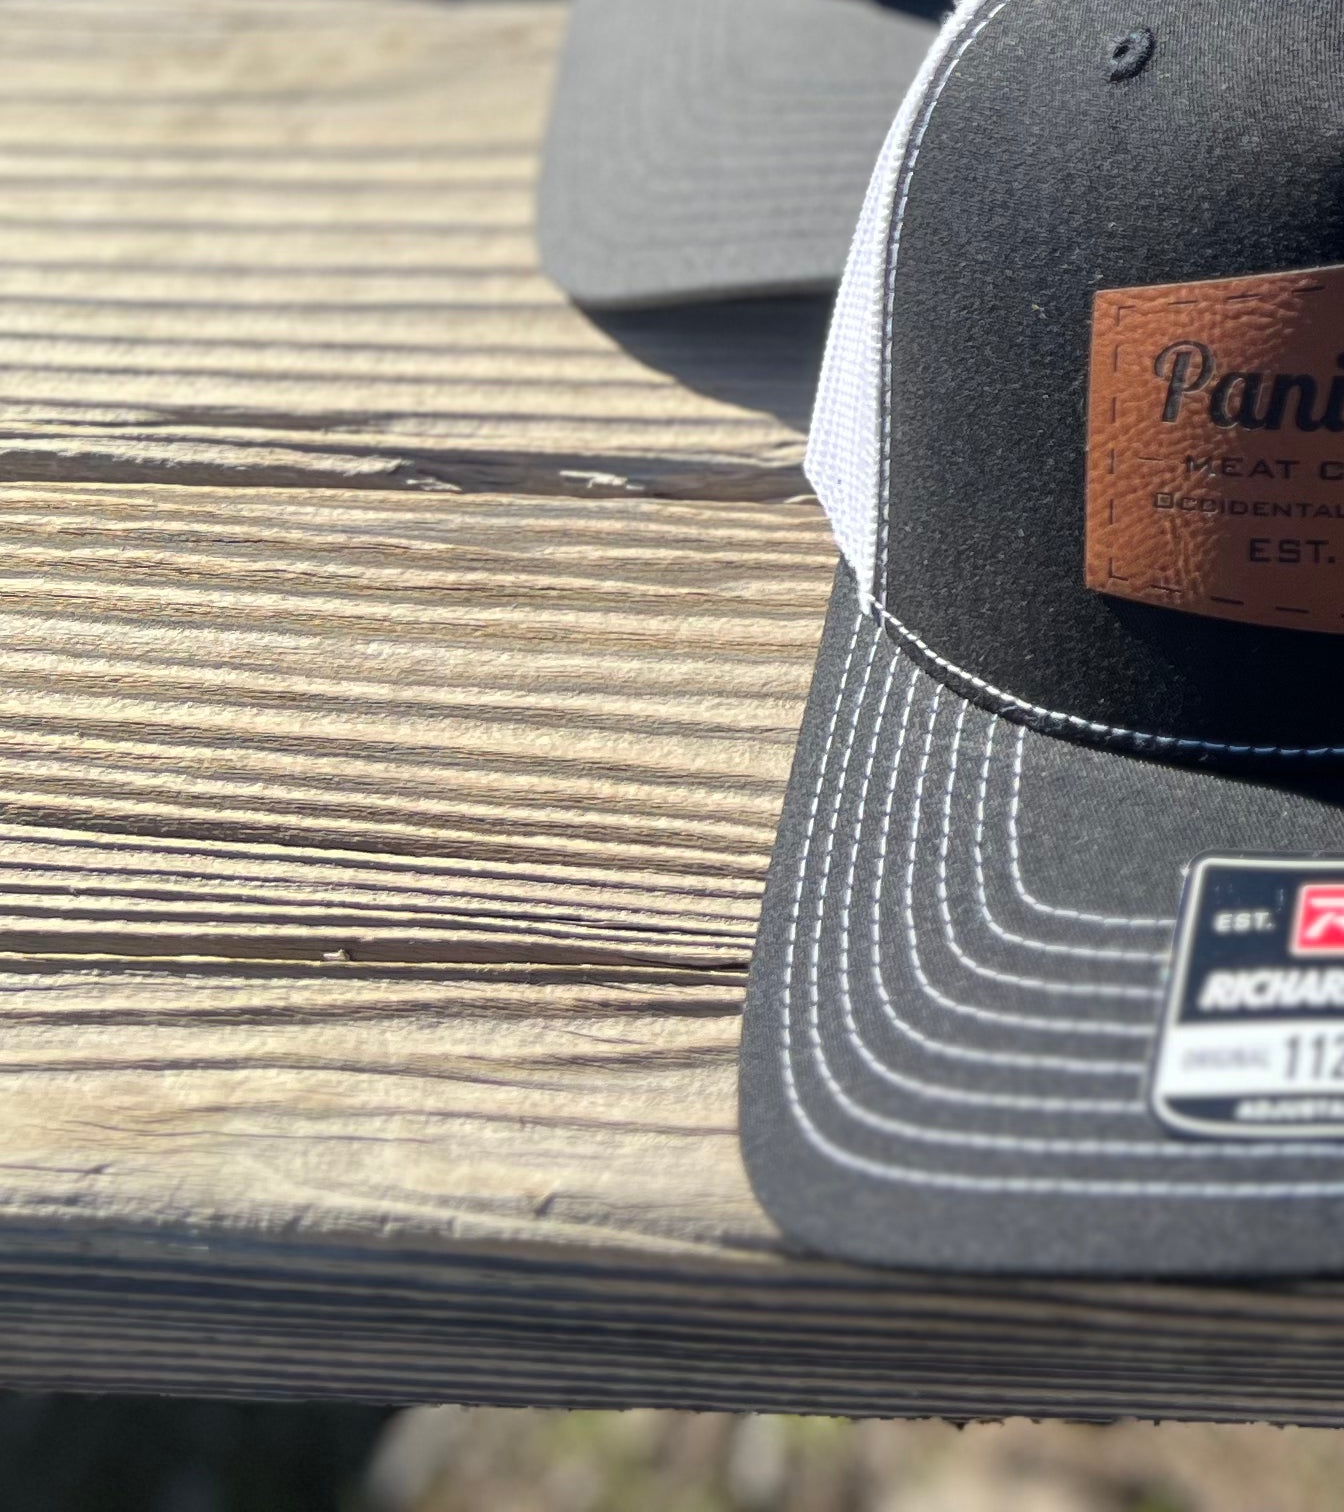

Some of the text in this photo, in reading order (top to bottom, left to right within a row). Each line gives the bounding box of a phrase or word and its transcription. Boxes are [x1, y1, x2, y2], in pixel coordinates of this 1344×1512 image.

[1184, 456, 1301, 481] MEAT
[1248, 537, 1337, 565] EST.
[1213, 910, 1275, 933] EST.
